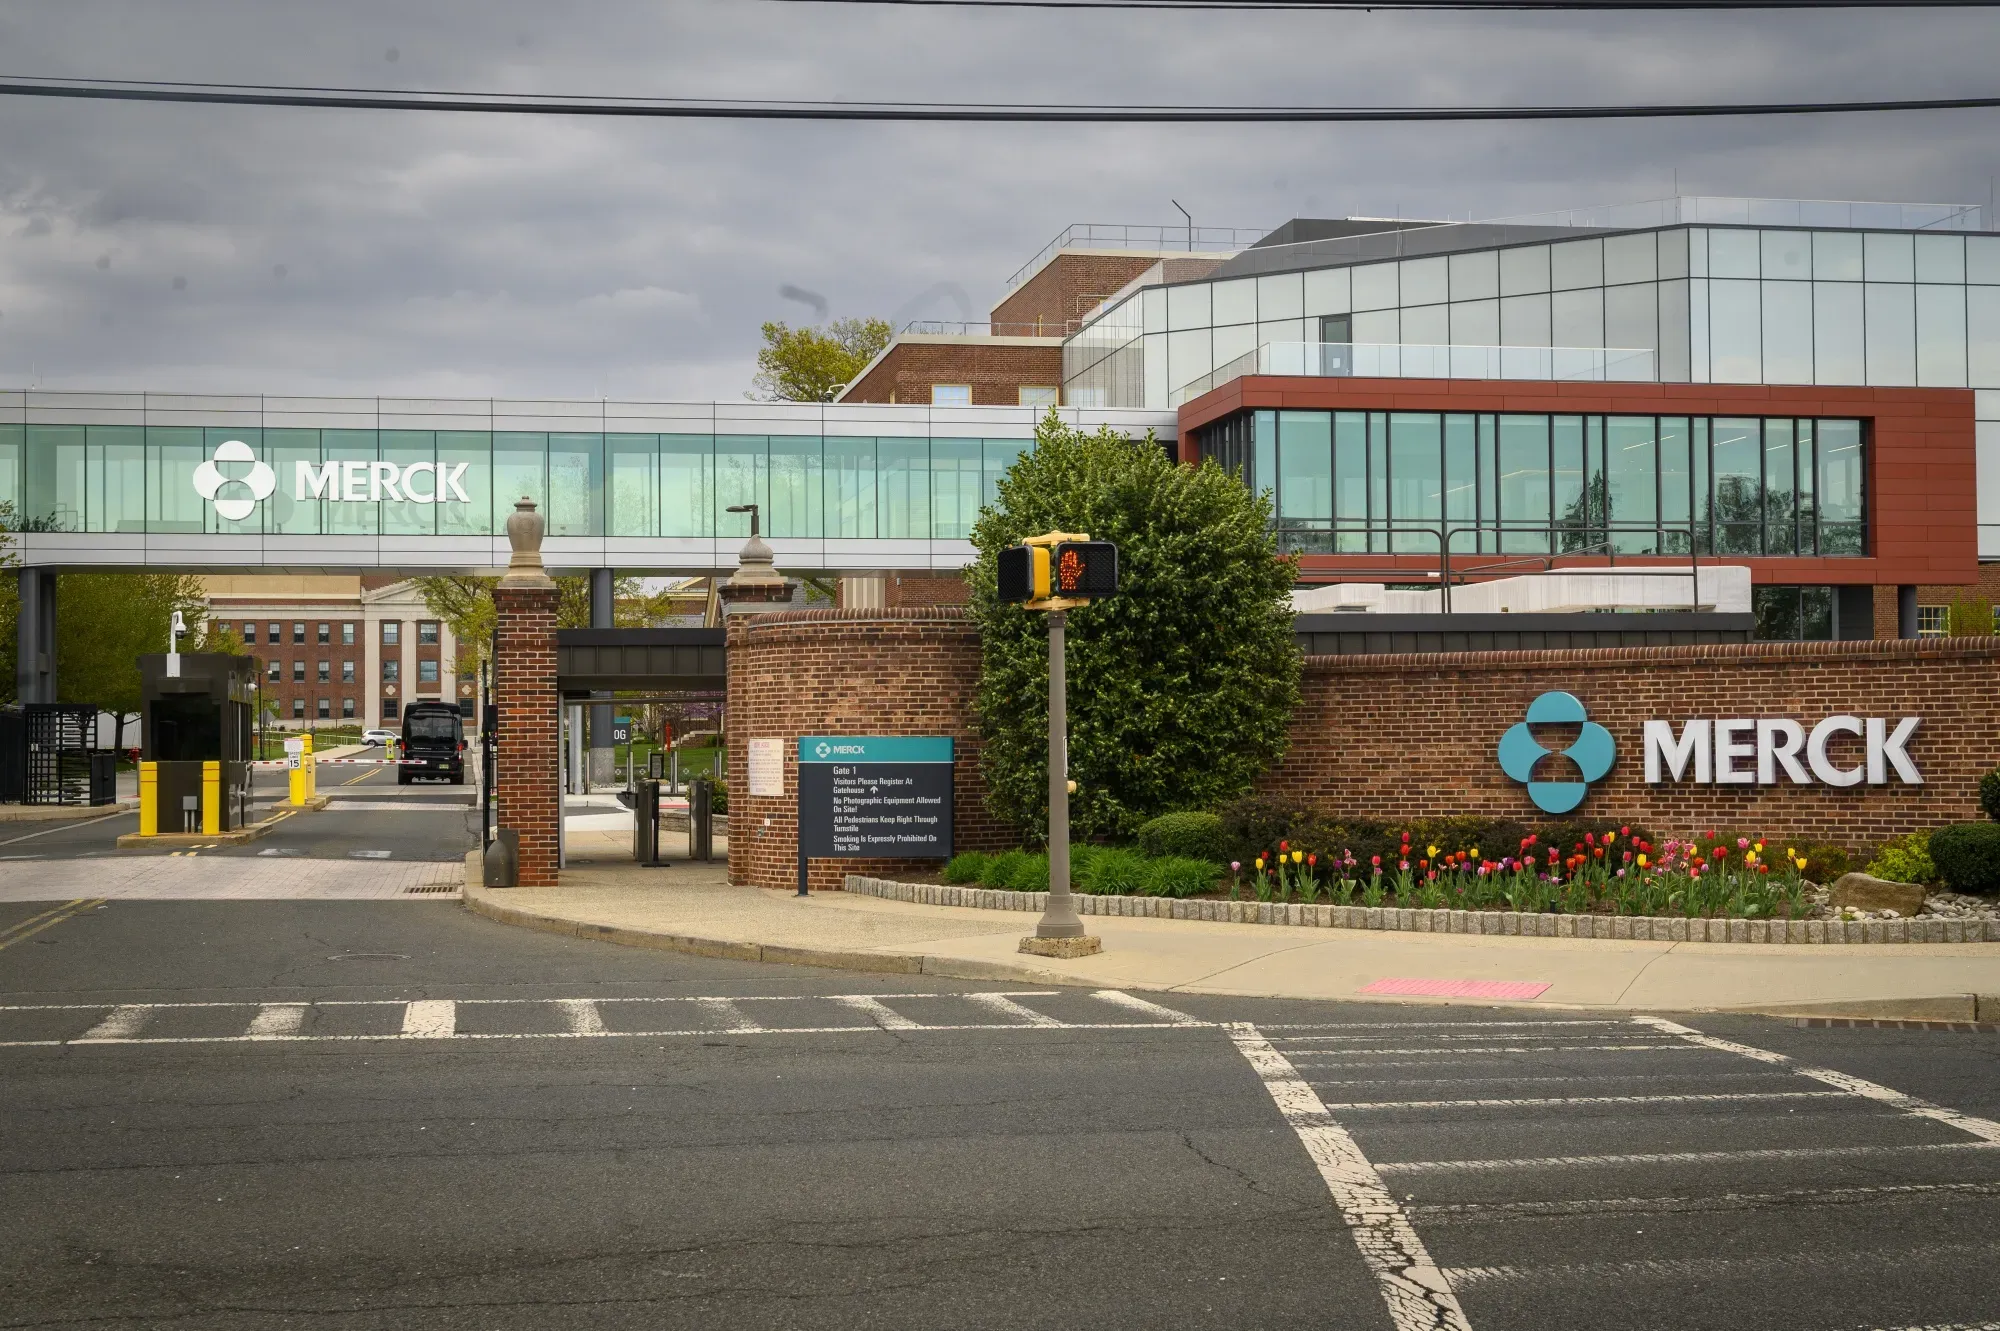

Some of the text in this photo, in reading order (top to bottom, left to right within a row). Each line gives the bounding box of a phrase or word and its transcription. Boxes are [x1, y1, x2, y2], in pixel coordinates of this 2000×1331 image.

[295, 460, 471, 504] MERCK
[614, 729, 626, 740] OG
[833, 745, 865, 754] MERCK
[1643, 715, 1925, 787] MERCK
[290, 759, 300, 768] 15
[834, 766, 856, 774] Gate 1
[880, 778, 904, 786] Register
[844, 797, 882, 805] Photographic
[884, 797, 914, 805] Equipment
[880, 816, 895, 824] Keep
